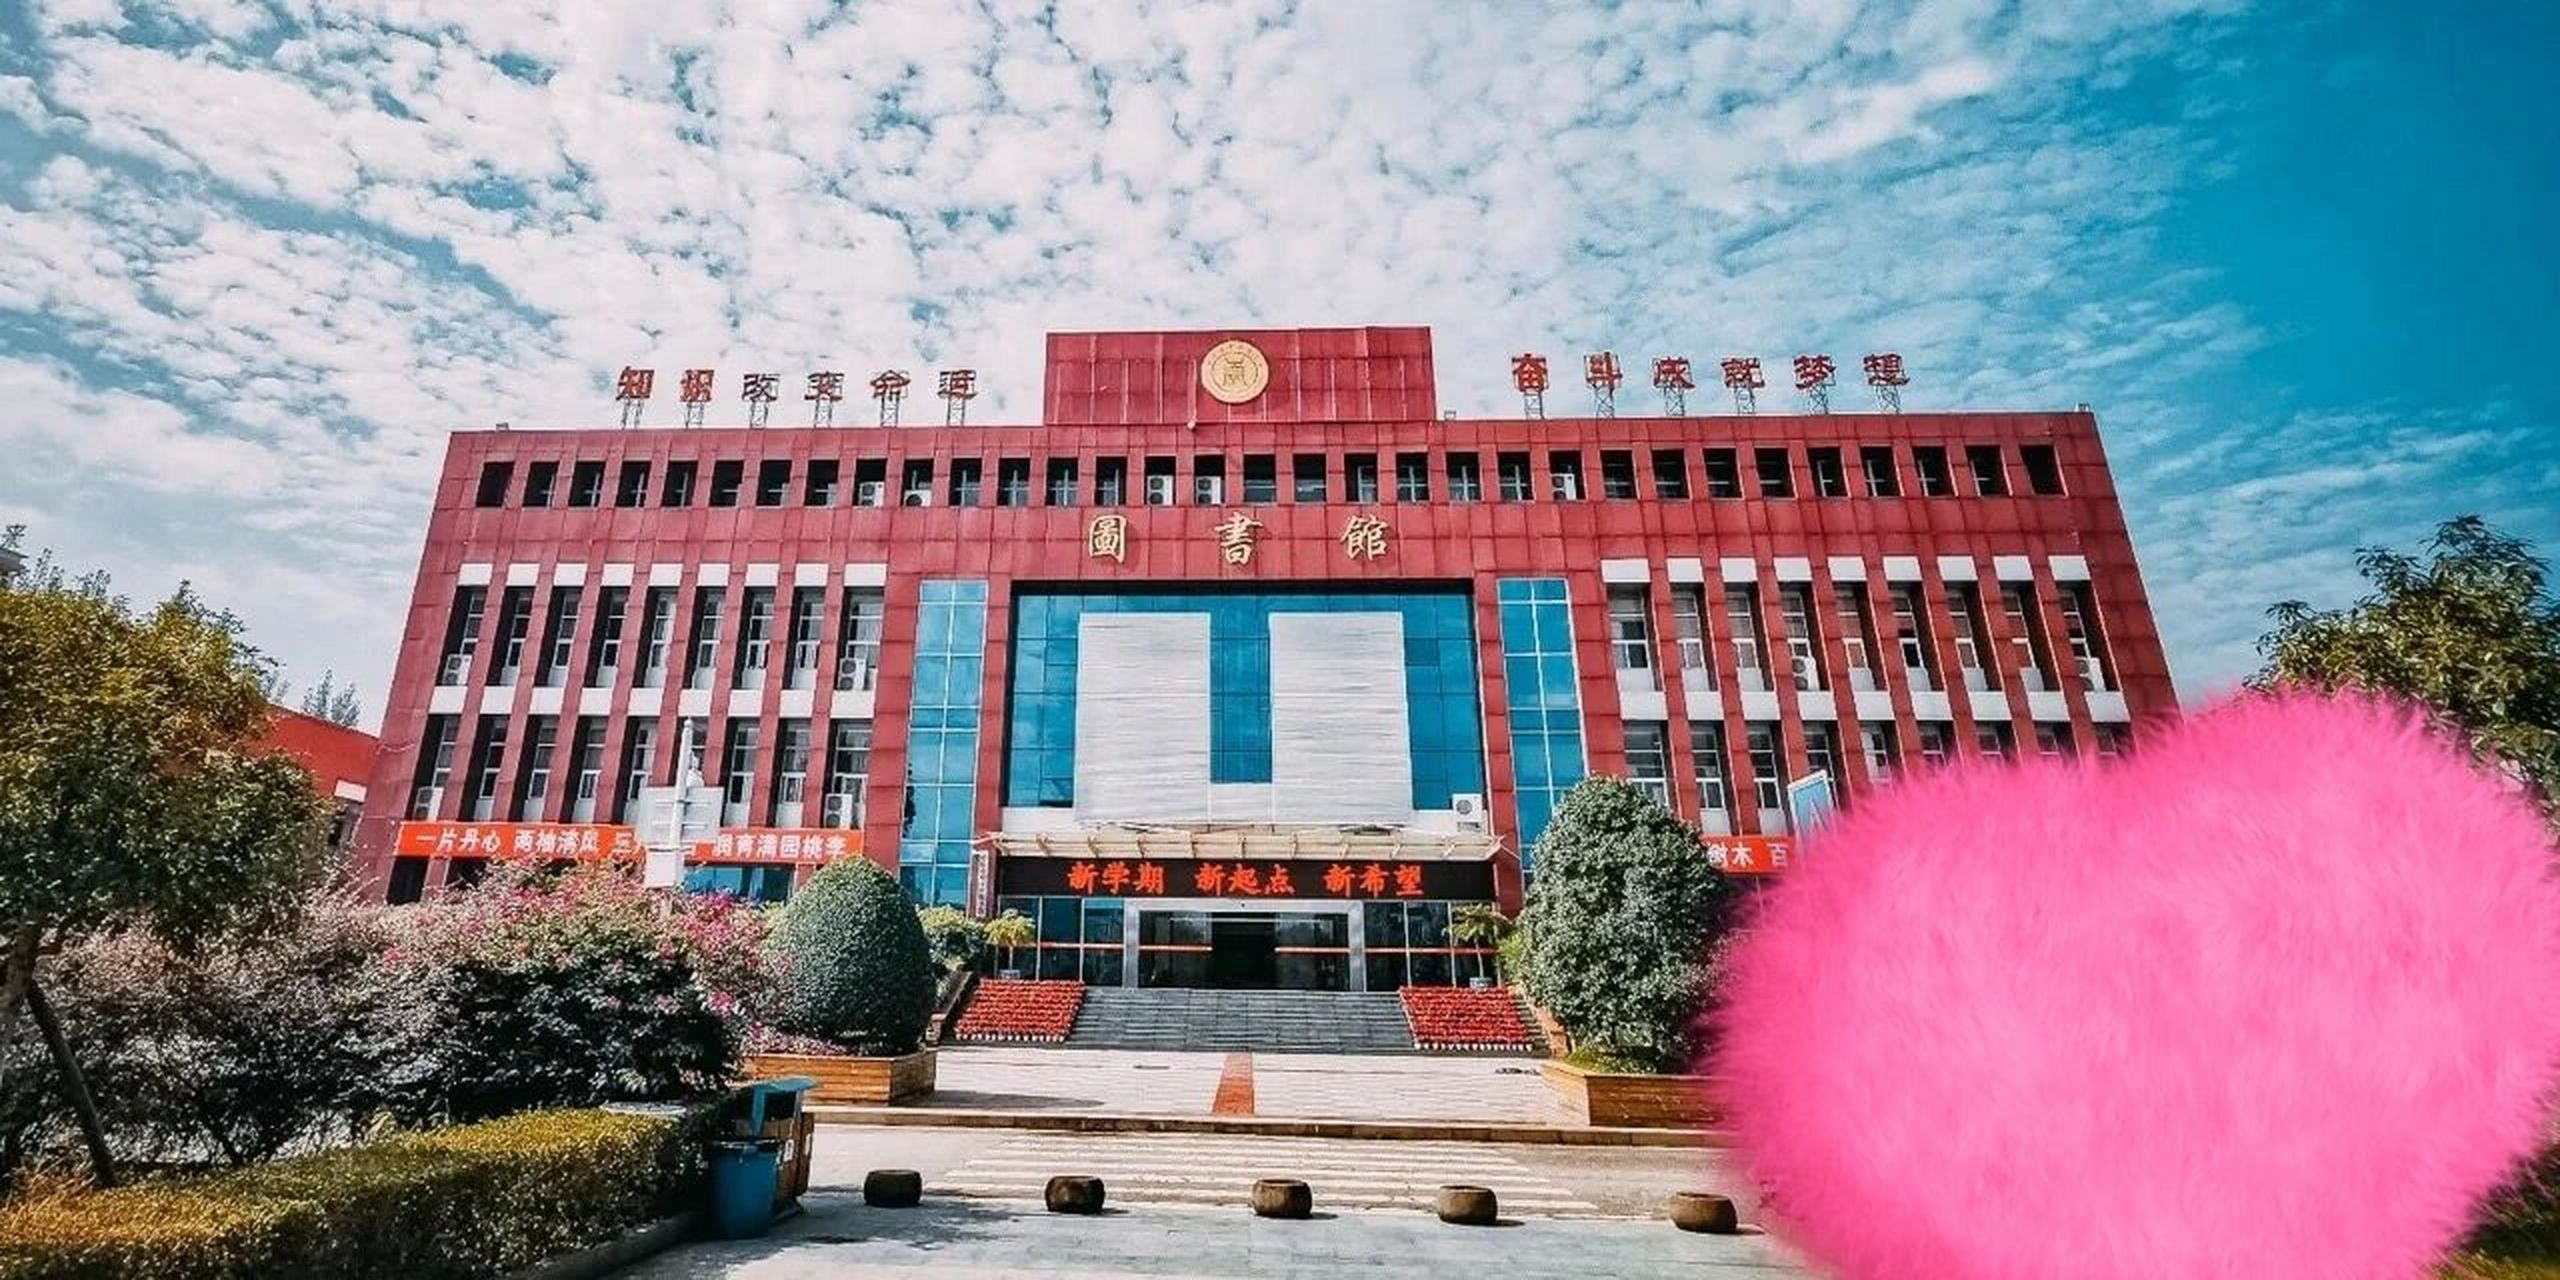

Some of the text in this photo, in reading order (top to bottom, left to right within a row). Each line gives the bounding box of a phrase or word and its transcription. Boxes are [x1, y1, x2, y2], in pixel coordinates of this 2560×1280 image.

[1511, 352, 1910, 392] 奋斗成就梦想
[1088, 511, 1389, 565] 圖書館
[415, 828, 501, 853] 一片丹心
[1067, 861, 1424, 897] 新学期 新起点 新希望
